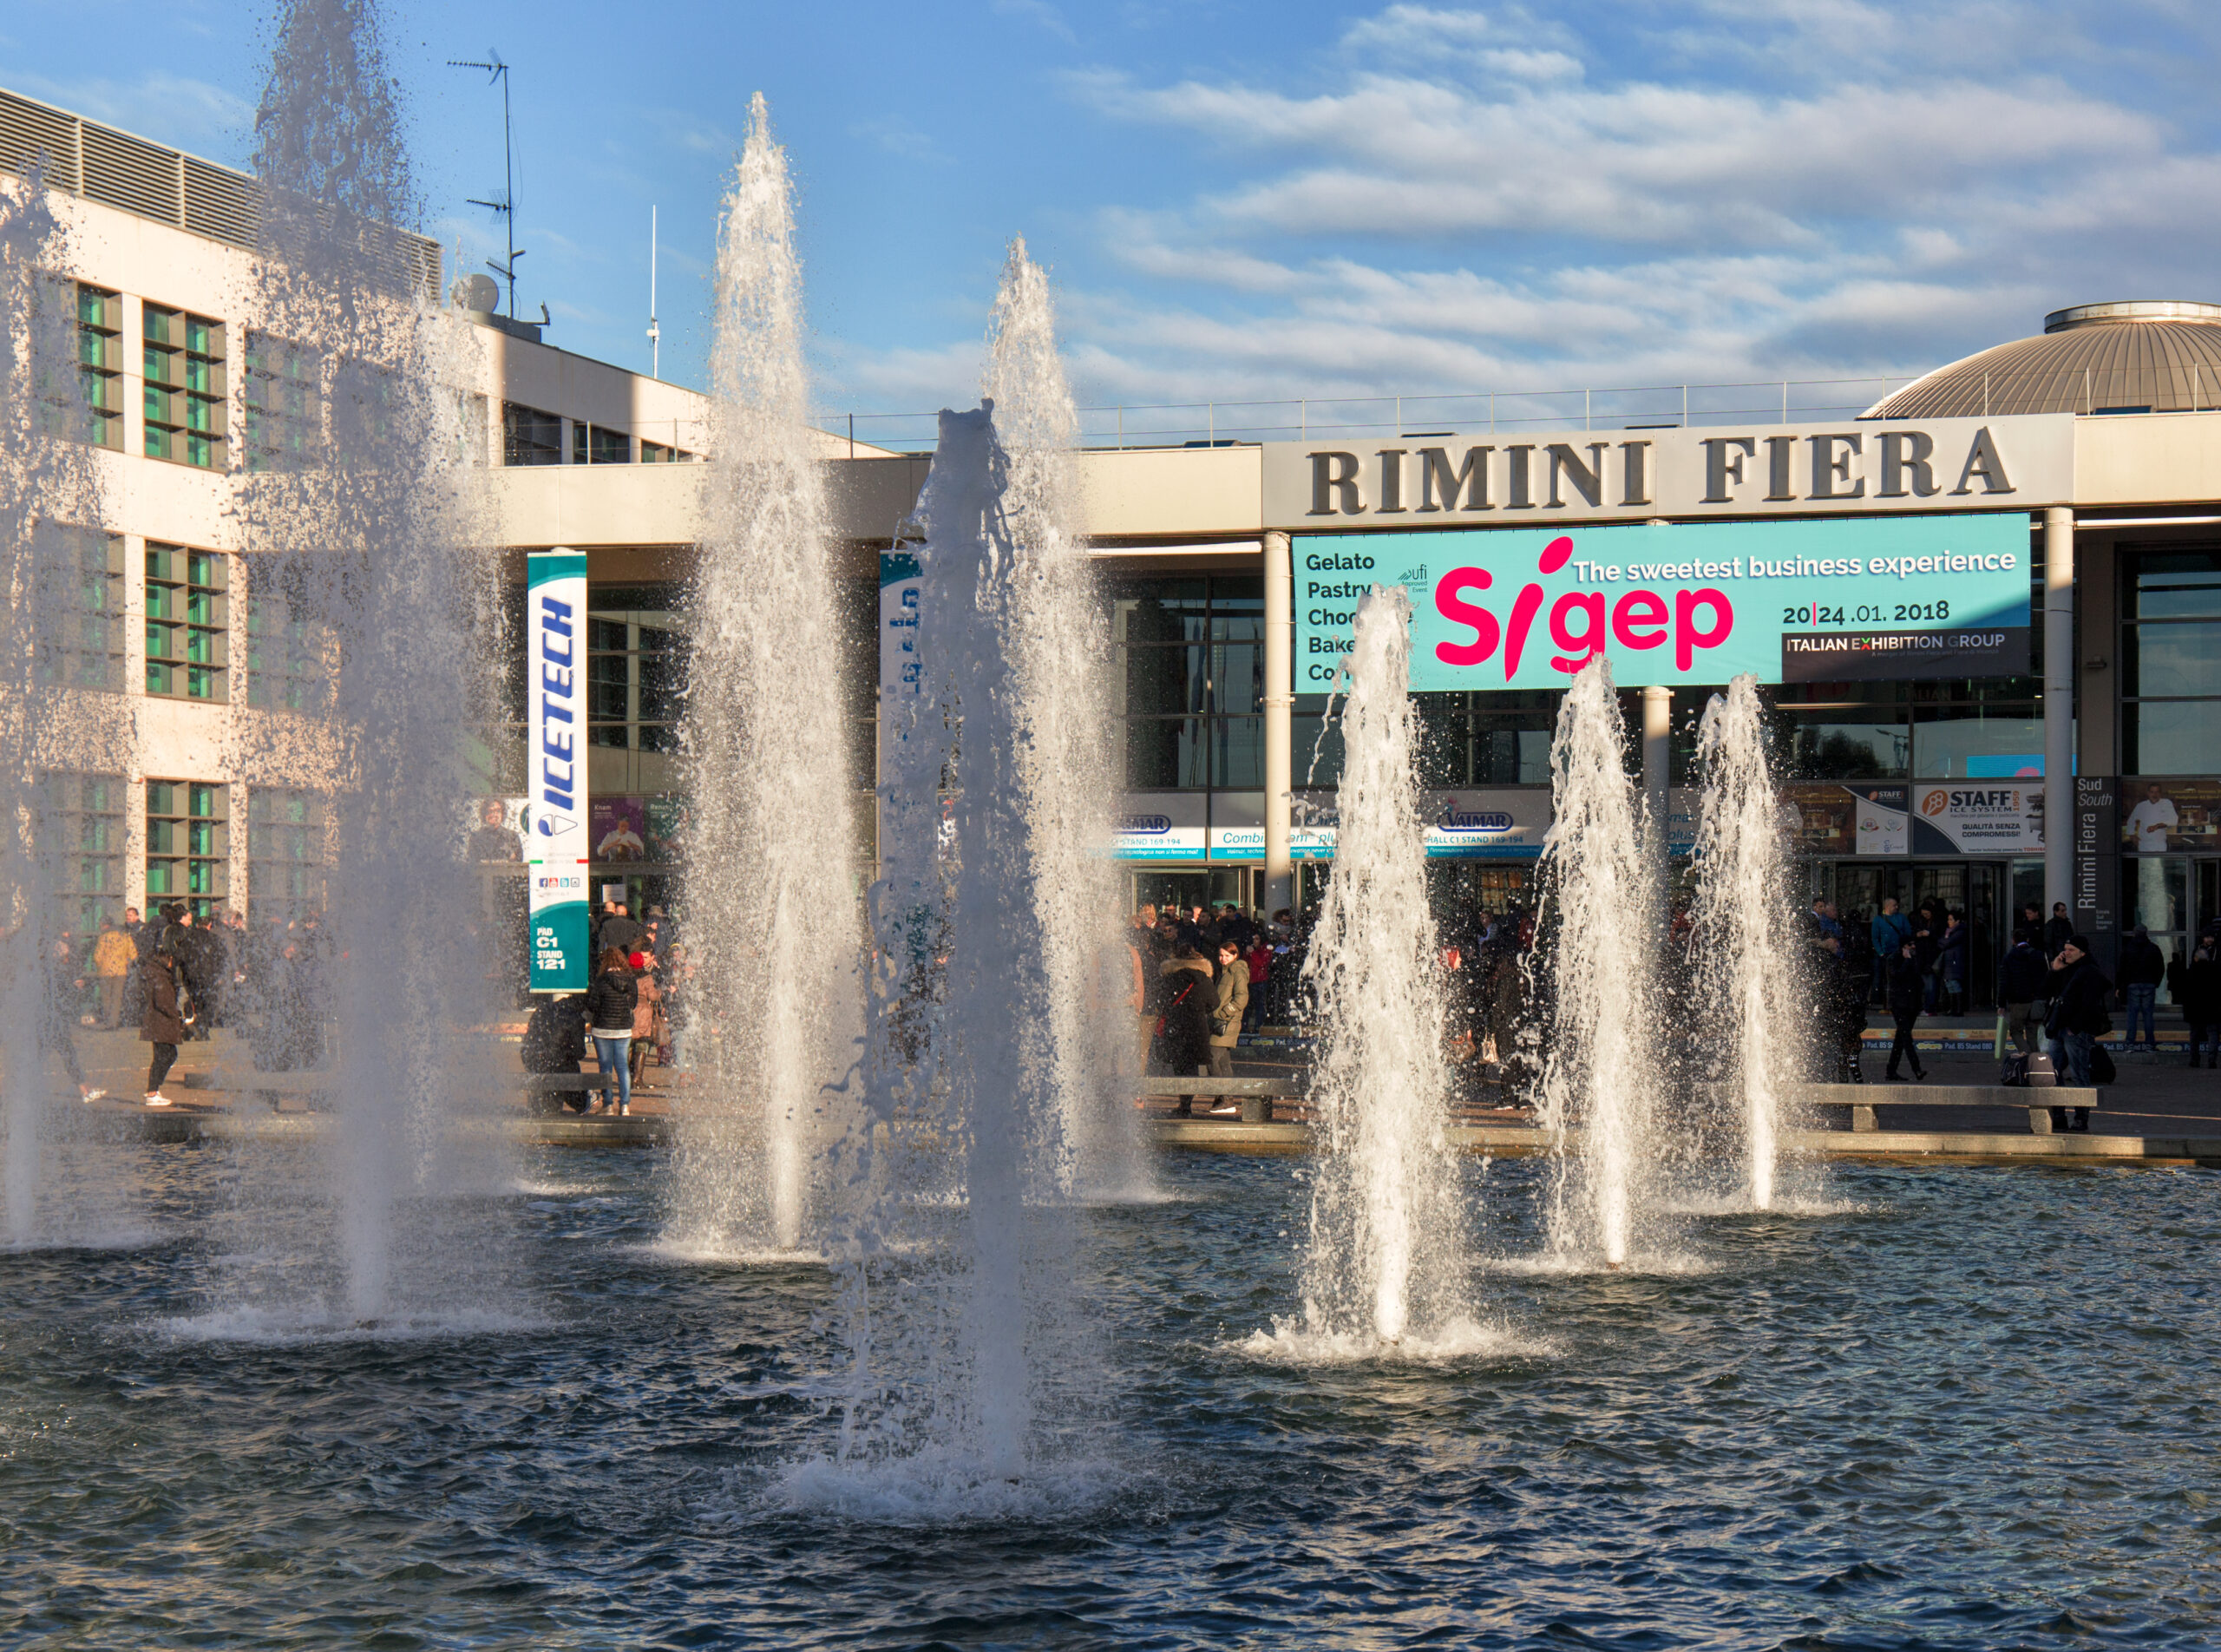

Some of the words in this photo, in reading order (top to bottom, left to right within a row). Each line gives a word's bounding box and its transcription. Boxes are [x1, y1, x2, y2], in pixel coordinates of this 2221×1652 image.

[1306, 441, 1653, 516] RIMINI
[1699, 425, 2018, 504] FIERA
[1306, 553, 1376, 571] Gelato
[1573, 560, 1622, 582] The
[1627, 556, 1743, 580] sweetest
[1747, 554, 1863, 578] business
[1868, 549, 2017, 579] experience
[1434, 535, 1734, 683] Sigep
[1894, 600, 1950, 620] 2018
[1786, 638, 1848, 652] ITALIAN
[1851, 635, 1943, 651] EXHIBITION
[1947, 633, 2006, 648] GROUP
[541, 595, 575, 811] ICETECH
[2077, 777, 2102, 791] Sud
[1949, 790, 2012, 807] STAFF
[2078, 792, 2113, 806] South
[1447, 814, 1507, 828] VALMAR
[1491, 835, 1523, 843] 169-194
[2077, 812, 2096, 853] Fiera
[2077, 856, 2096, 909] Rimini
[536, 928, 554, 936] PAD
[536, 937, 558, 948] C1
[537, 949, 563, 959] STAND
[536, 959, 566, 970] 121
[1944, 1041, 1956, 1050] Pad.
[1966, 1041, 1981, 1050] Stand
